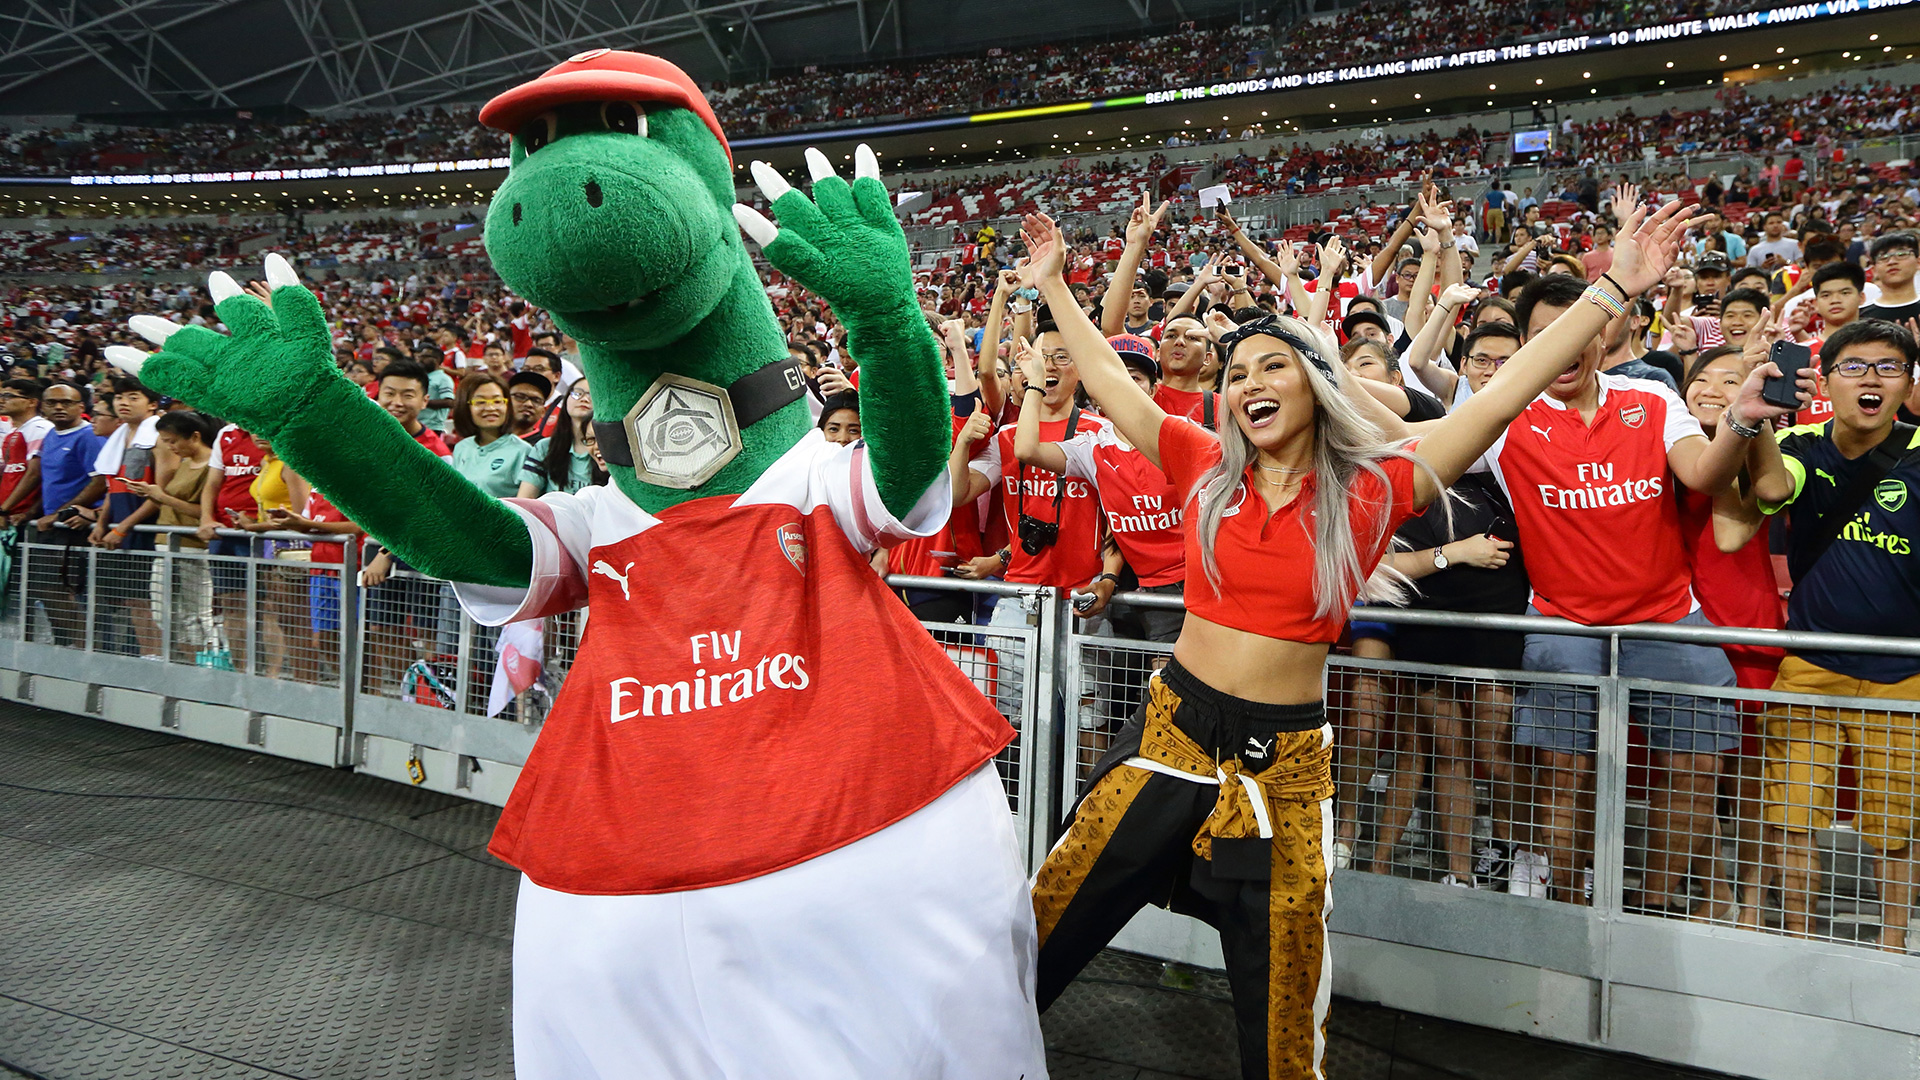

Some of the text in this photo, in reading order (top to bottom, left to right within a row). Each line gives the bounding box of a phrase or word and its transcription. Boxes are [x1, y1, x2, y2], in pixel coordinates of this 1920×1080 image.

[1145, 90, 1177, 104] BEAT
[1181, 87, 1206, 100] THE
[1210, 79, 1267, 96] CROWDS
[1271, 74, 1302, 89] AND
[1307, 70, 1334, 85] USE
[1339, 61, 1406, 80] KALLANG
[1411, 56, 1444, 72] MRT
[1449, 49, 1496, 67] AFTER
[1501, 44, 1532, 60] THE
[1537, 36, 1590, 55] EVENT
[1609, 31, 1629, 46] 10
[1635, 20, 1702, 43] MINUTE
[1708, 12, 1760, 33] WALK
[1767, 4, 1819, 25] AWAY
[1826, 0, 1860, 16] VIA
[1576, 462, 1614, 482] Fly
[1131, 494, 1162, 511] Fly
[1537, 476, 1663, 510] Emirates
[690, 629, 742, 665] Fly
[609, 652, 810, 724] Emirates
